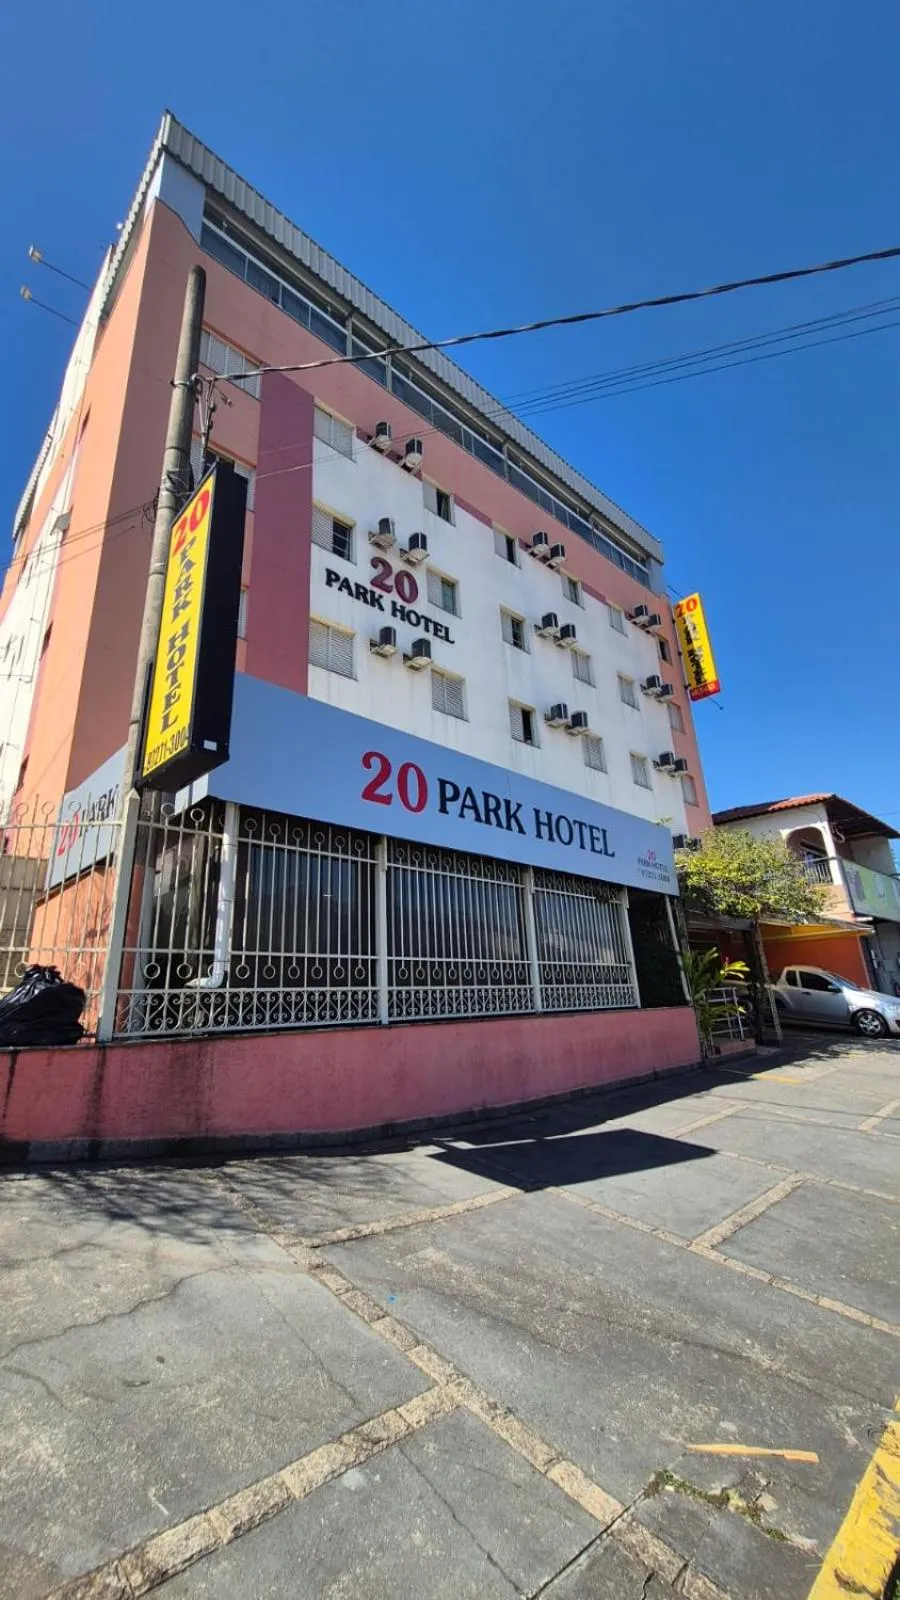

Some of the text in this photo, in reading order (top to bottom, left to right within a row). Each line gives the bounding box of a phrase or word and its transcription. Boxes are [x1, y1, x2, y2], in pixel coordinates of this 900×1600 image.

[171, 489, 210, 558] 20
[325, 567, 455, 645] PARK HOTEL
[369, 556, 419, 604] 20
[674, 598, 698, 619] 20
[160, 536, 197, 735] PARK HOTEL
[361, 751, 616, 859] 20 PARK HOTEL
